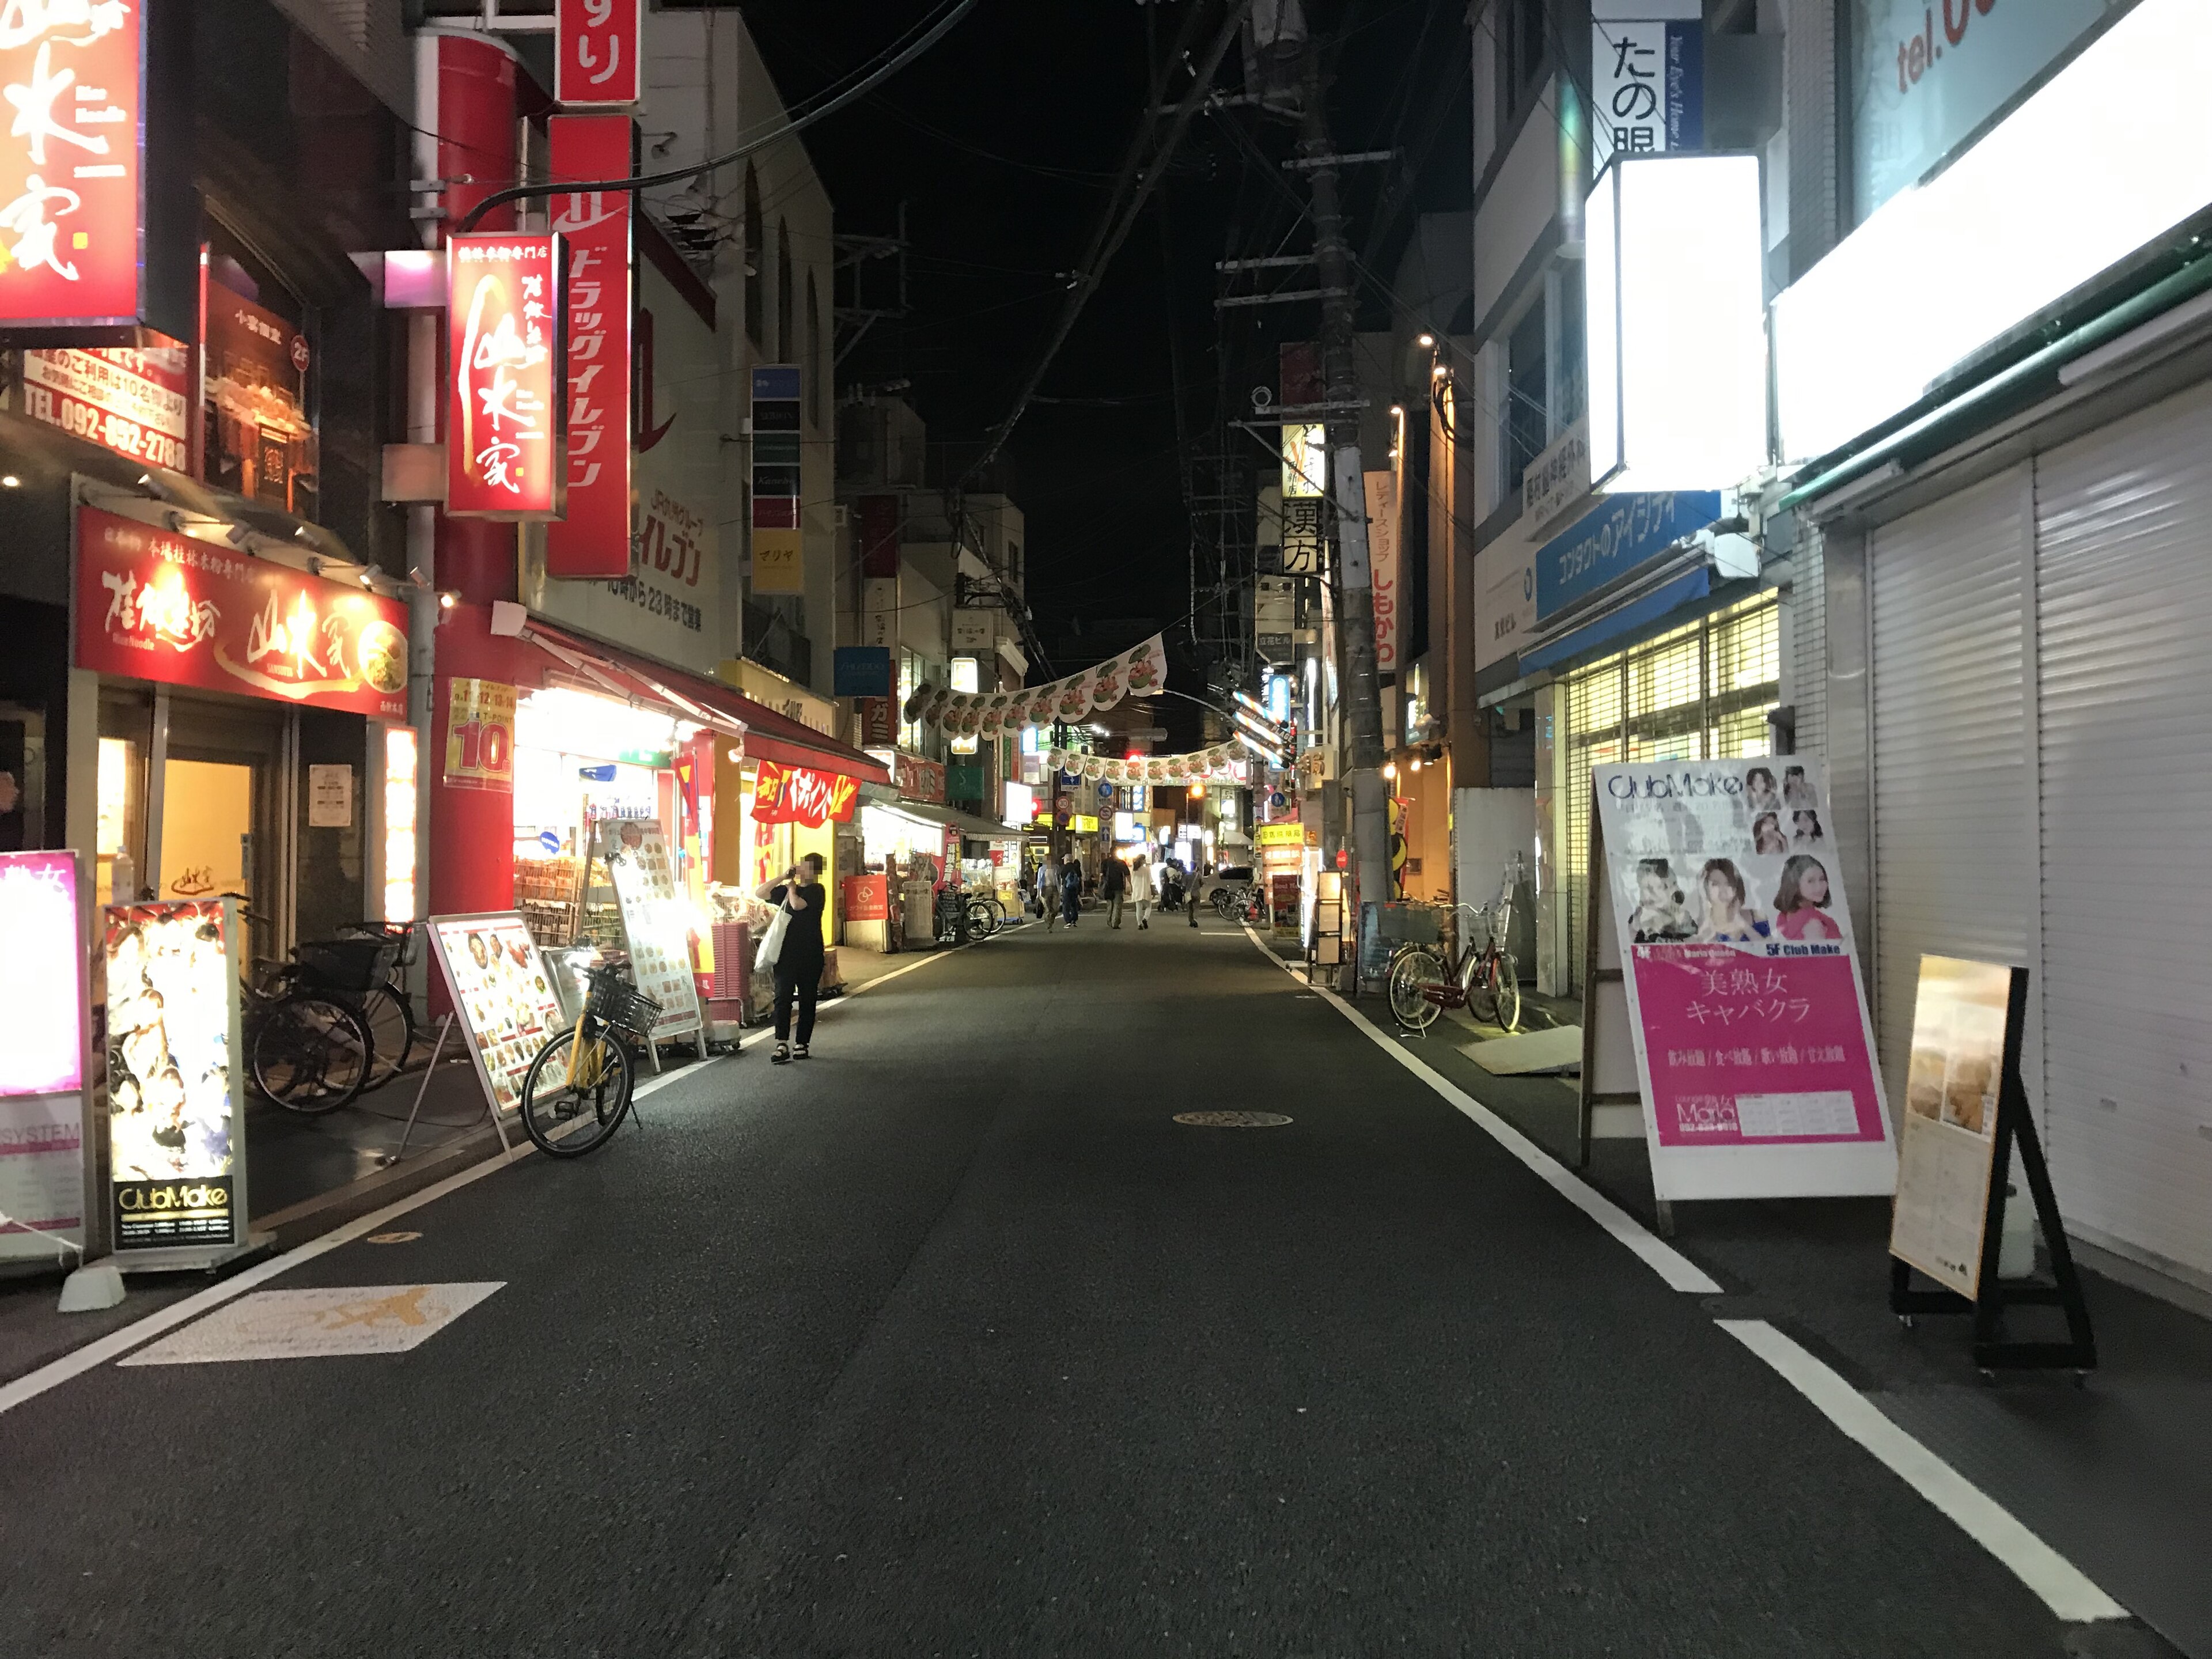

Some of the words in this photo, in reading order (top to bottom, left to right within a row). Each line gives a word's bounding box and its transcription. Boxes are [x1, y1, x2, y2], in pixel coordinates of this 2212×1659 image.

[568, 245, 607, 487] ドラッグイレブン
[1284, 502, 1316, 571] 漢方
[760, 549, 794, 563] マリヤ
[1373, 569, 1395, 664] しもかわ
[1258, 635, 1291, 646] 立花ビル
[870, 697, 891, 741] ガミ
[1271, 725, 1294, 744] PLAGE
[1766, 944, 1780, 957] 5F
[1783, 944, 1809, 955] Club
[1810, 944, 1840, 955] Make
[1702, 968, 1787, 997] 美熟女
[1687, 997, 1810, 1025] キャバクラ
[1, 1123, 80, 1143] SYSTEM
